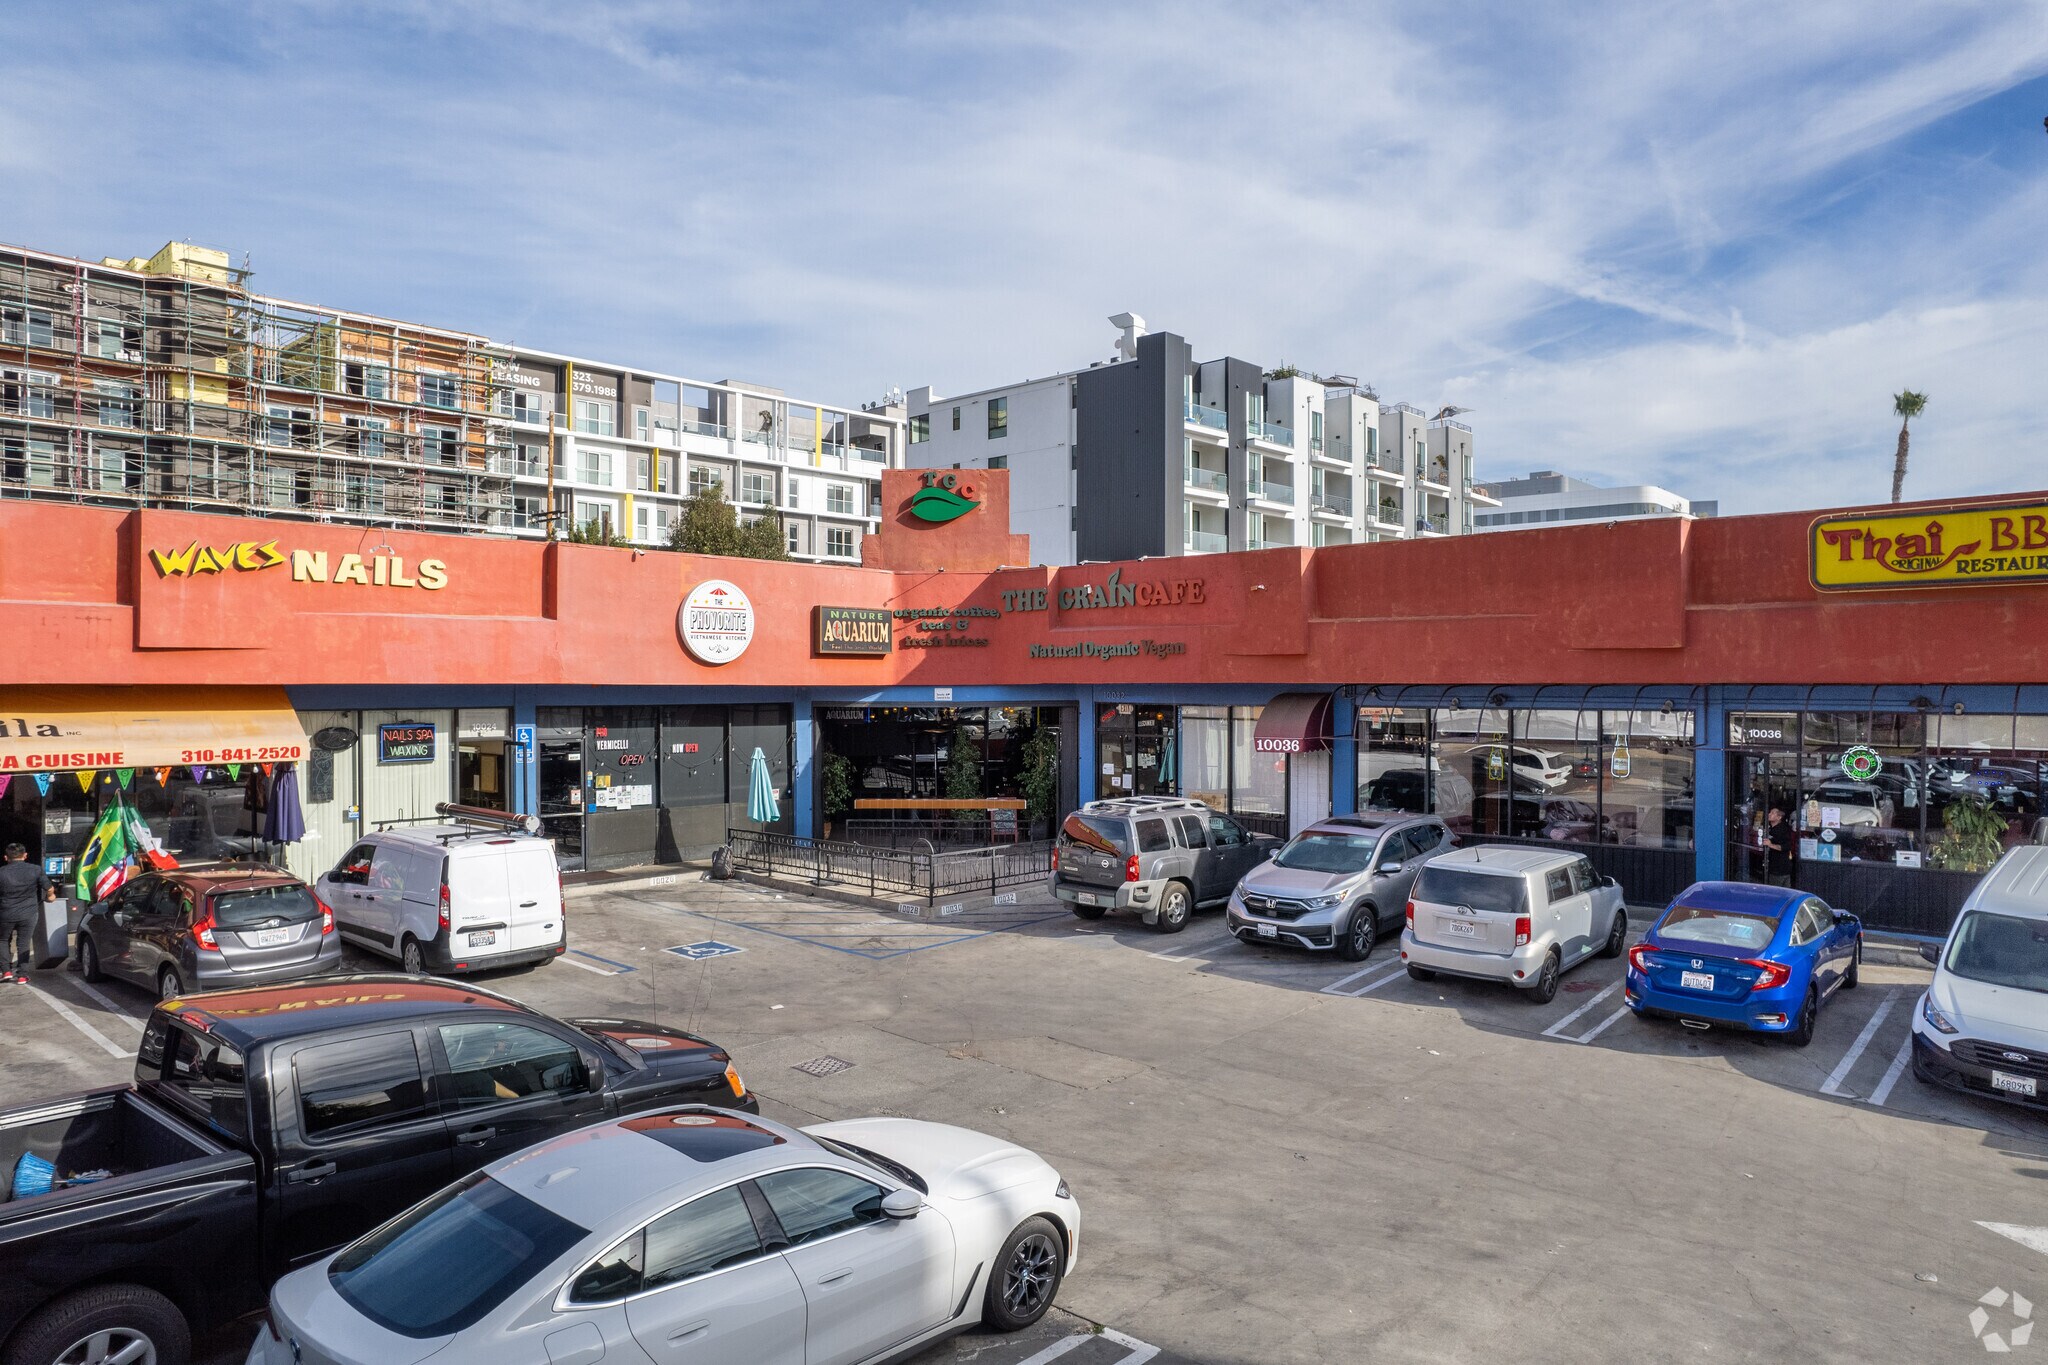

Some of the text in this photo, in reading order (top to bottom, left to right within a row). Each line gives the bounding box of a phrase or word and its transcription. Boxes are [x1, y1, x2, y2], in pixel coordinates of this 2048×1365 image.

[491, 371, 540, 386] LEASING
[572, 370, 593, 382] 323.
[572, 383, 617, 397] 379.1988
[1821, 521, 1944, 573] Thai
[150, 540, 287, 577] WAVES
[1891, 556, 1942, 570] ORIGINAL
[292, 549, 448, 589] NAILS
[1000, 587, 1048, 612] THE
[830, 610, 883, 620] NATURE
[894, 605, 1001, 619] organic coffee,
[691, 610, 746, 631] PHOVORITE
[921, 619, 969, 630] teas &
[824, 620, 889, 643] AQUARIUM
[904, 635, 943, 647] fresh
[1030, 640, 1186, 659] Natural Organic Vegan
[471, 722, 497, 732] 10024
[1748, 729, 1782, 739] 10036
[384, 730, 434, 741] NAILS SPA
[390, 744, 428, 756] WAXING
[597, 739, 628, 750] VERMICELLI
[672, 743, 699, 753] NOW OPEN
[1256, 739, 1299, 752] 10036
[26, 752, 124, 768] CUISINE
[181, 746, 301, 763] 310-841-2520
[620, 754, 645, 765] OPEN
[995, 894, 1015, 904] 10032
[1996, 1077, 2033, 1093] 16809K3
